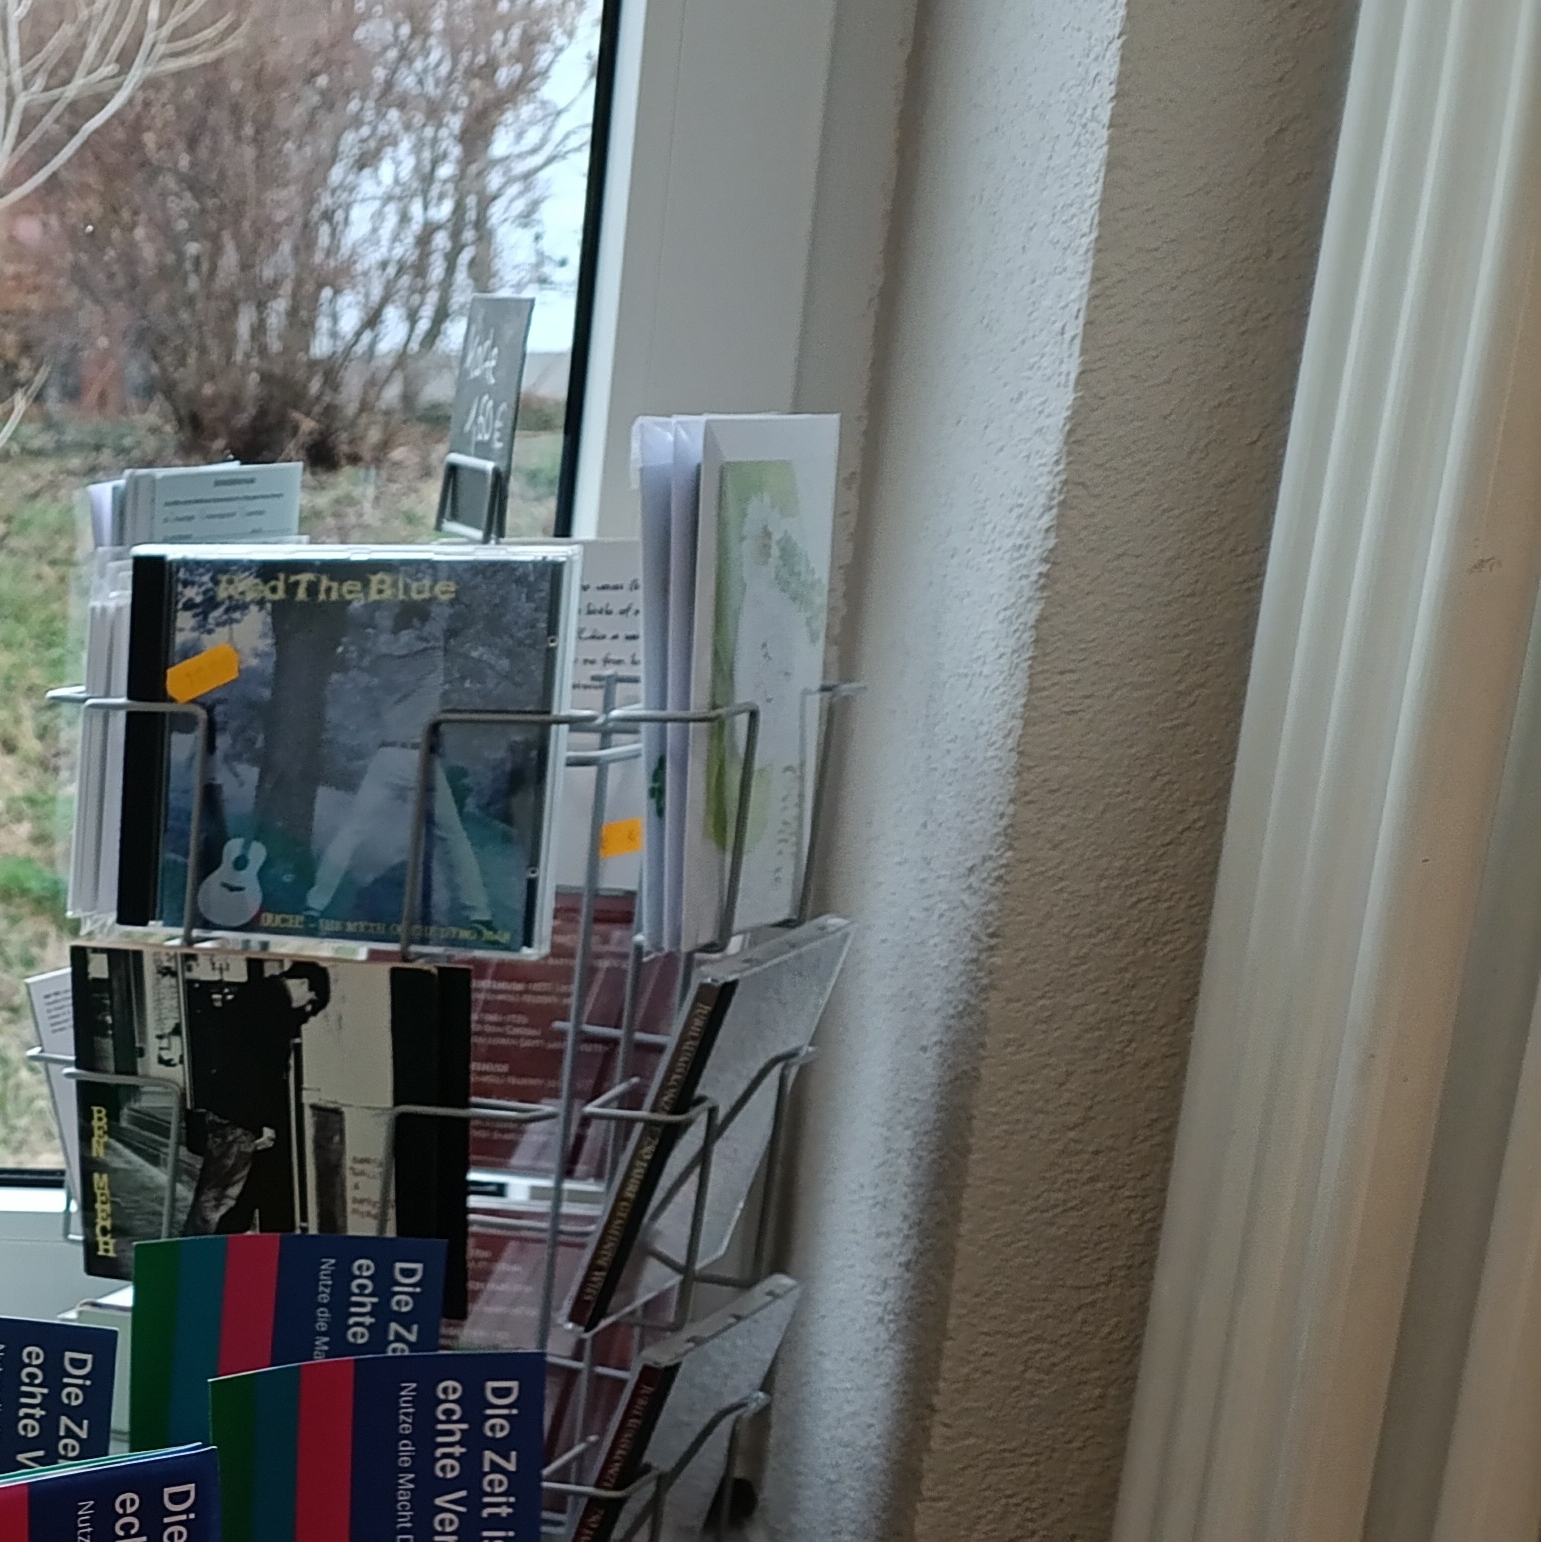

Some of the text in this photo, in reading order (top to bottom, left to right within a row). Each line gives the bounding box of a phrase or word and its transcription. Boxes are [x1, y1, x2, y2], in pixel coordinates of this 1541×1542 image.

[315, 1258, 336, 1332] Nutze die
[347, 1259, 379, 1344] echte
[391, 1262, 424, 1313] Die
[17, 1346, 49, 1438] echte
[61, 1351, 93, 1406] Die
[398, 1382, 417, 1434] Nutze
[434, 1380, 469, 1479] echte
[483, 1380, 519, 1438] Die
[397, 1440, 416, 1468] die
[396, 1473, 415, 1529] Macht
[482, 1450, 516, 1518] Zeit
